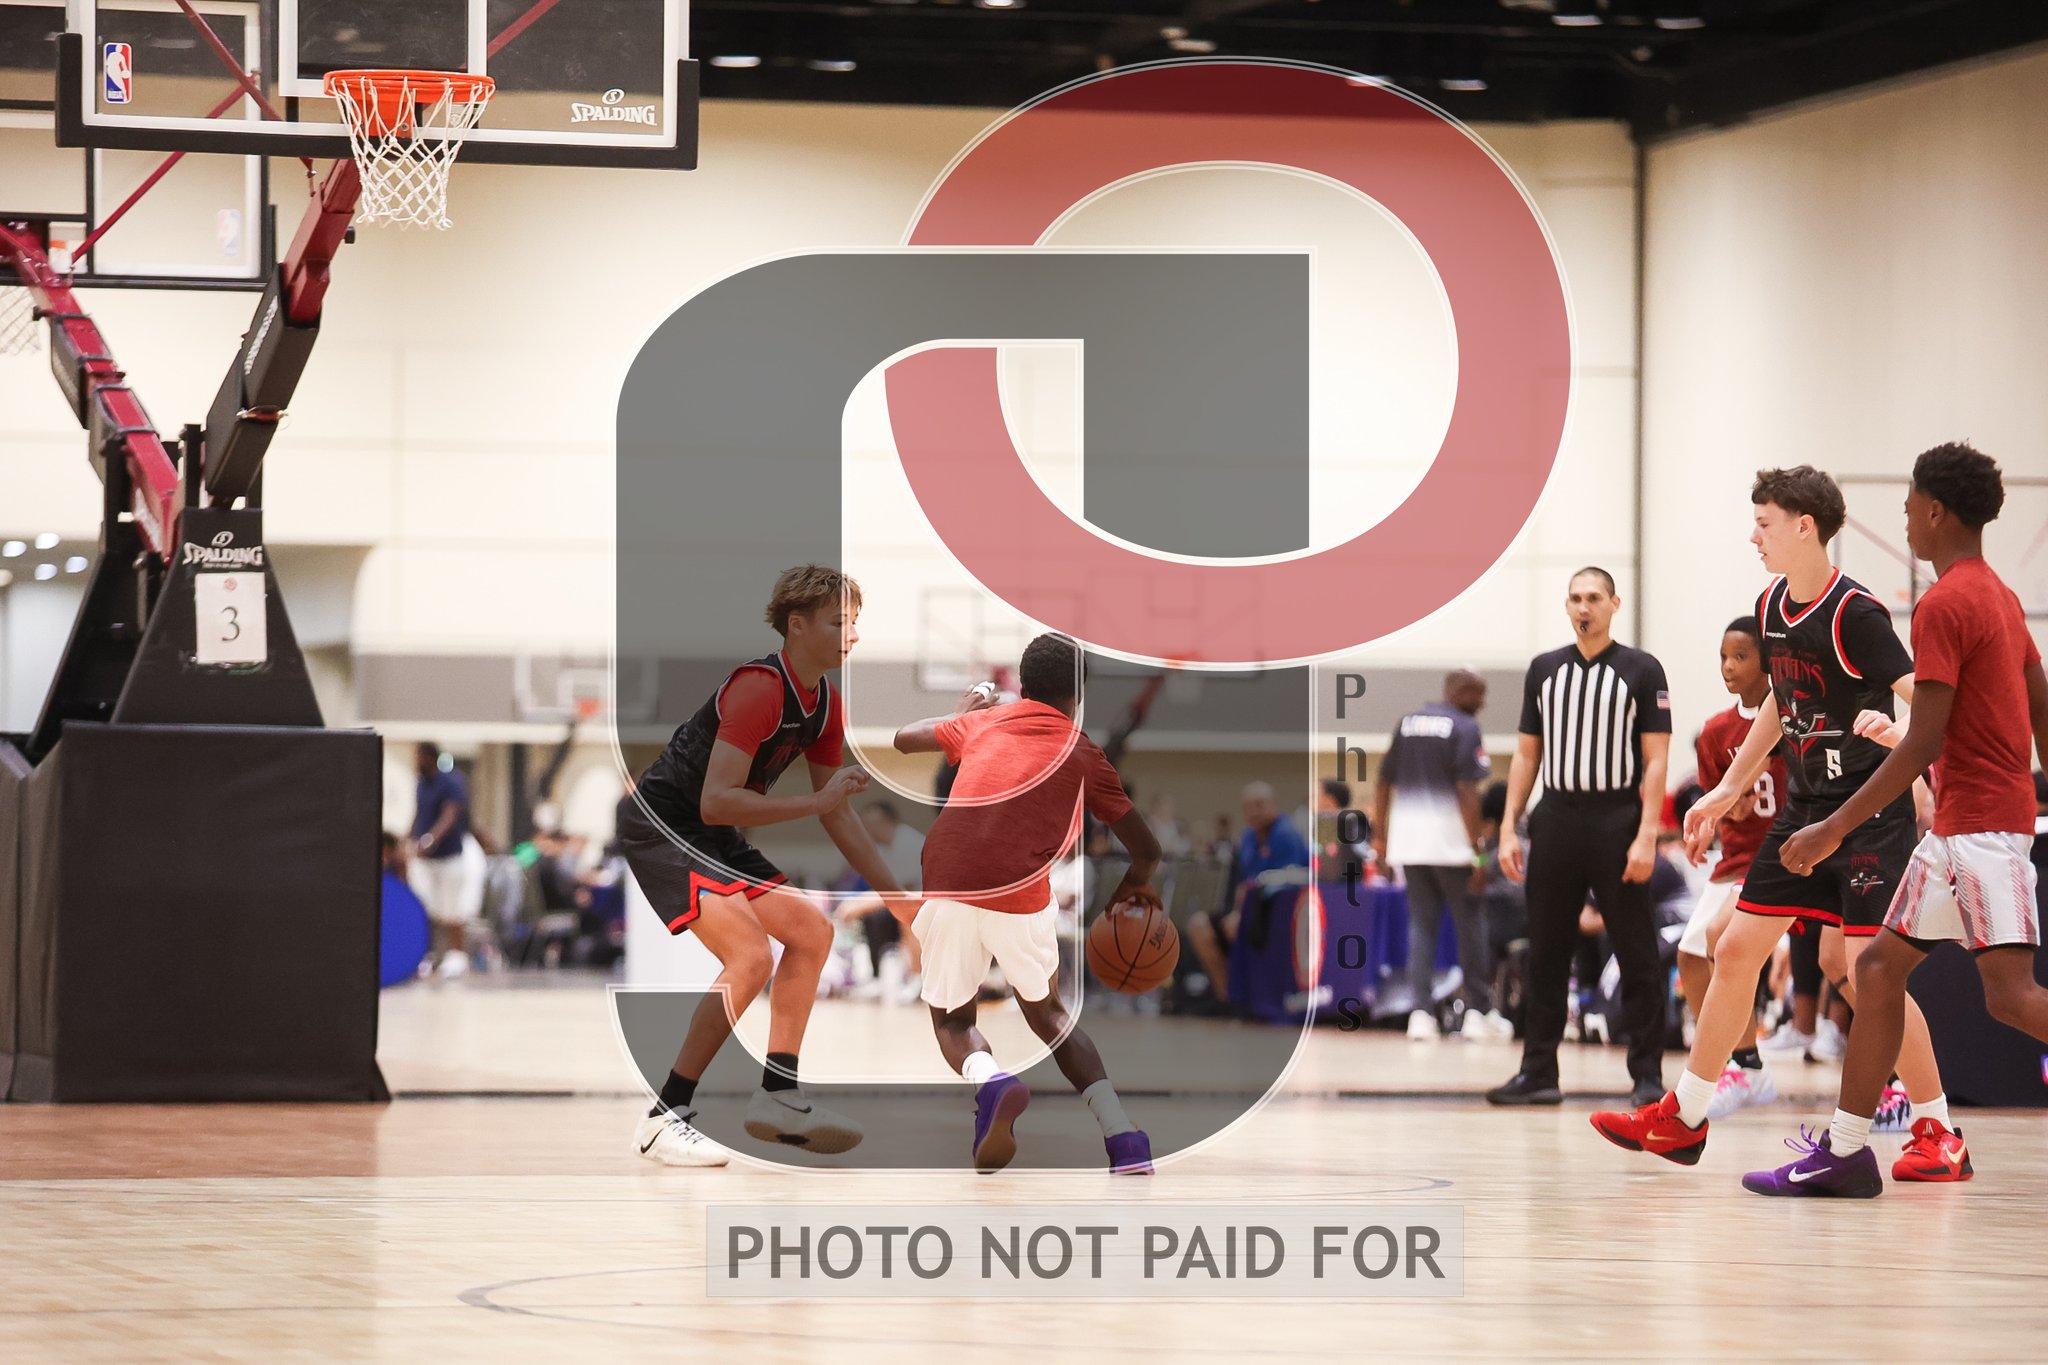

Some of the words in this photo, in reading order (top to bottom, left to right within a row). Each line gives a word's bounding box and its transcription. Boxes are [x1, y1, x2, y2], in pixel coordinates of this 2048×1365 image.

[571, 102, 658, 126] SPALDING
[182, 542, 263, 566] SPALDING
[221, 606, 241, 642] 3
[1769, 655, 1826, 698] TITANS
[1825, 748, 1843, 780] 5
